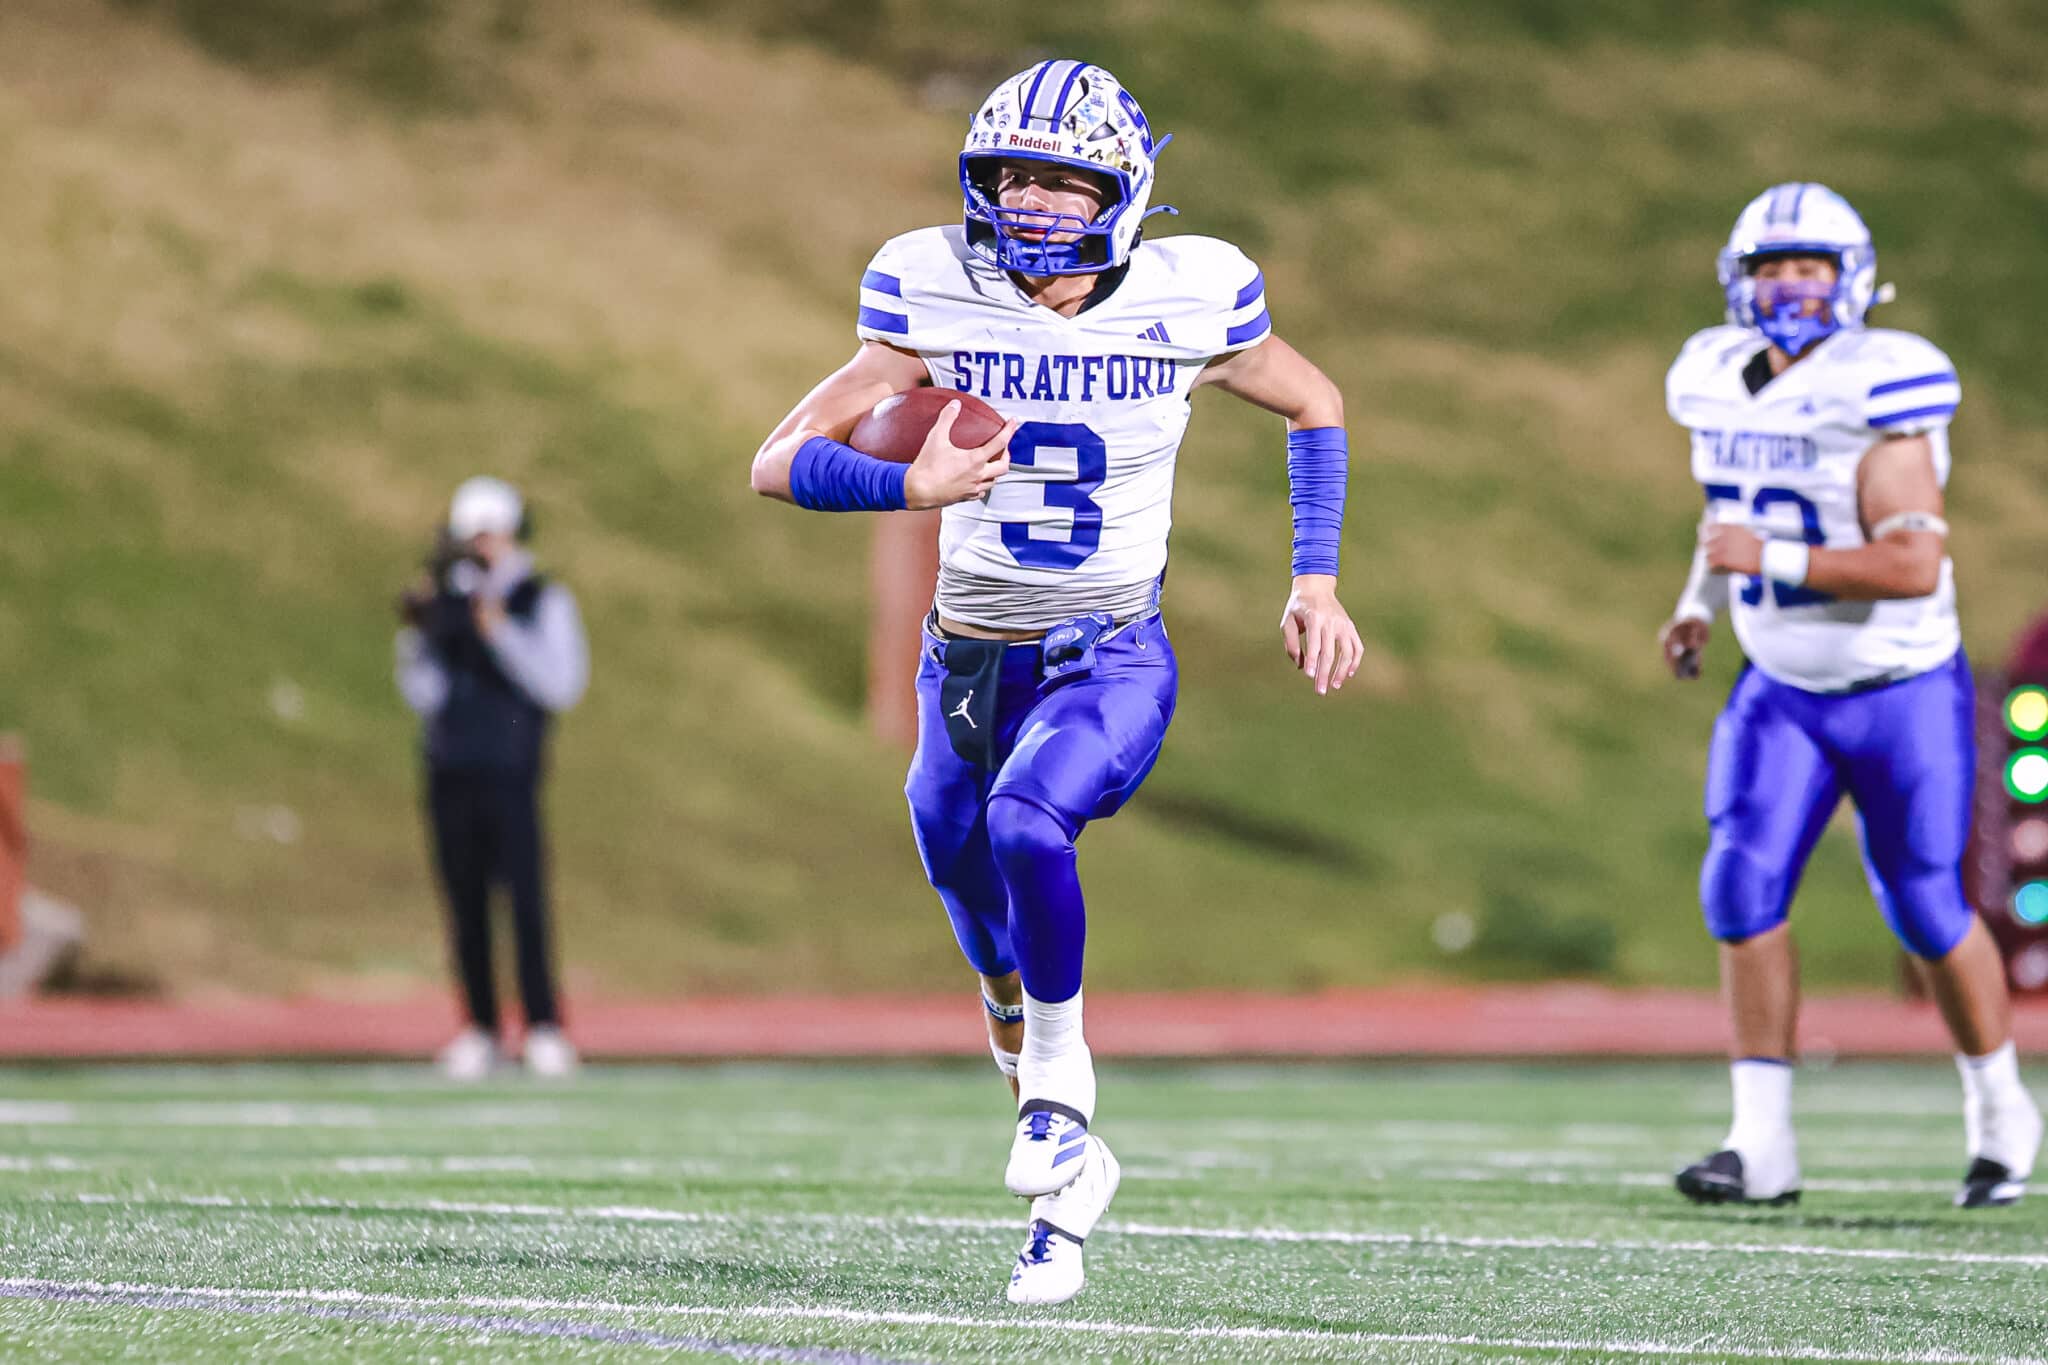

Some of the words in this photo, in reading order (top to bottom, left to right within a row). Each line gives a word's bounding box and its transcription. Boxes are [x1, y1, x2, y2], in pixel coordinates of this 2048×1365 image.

[1008, 133, 1062, 153] Riddell
[952, 350, 1176, 402] STRATFORD
[1000, 420, 1107, 571] 3
